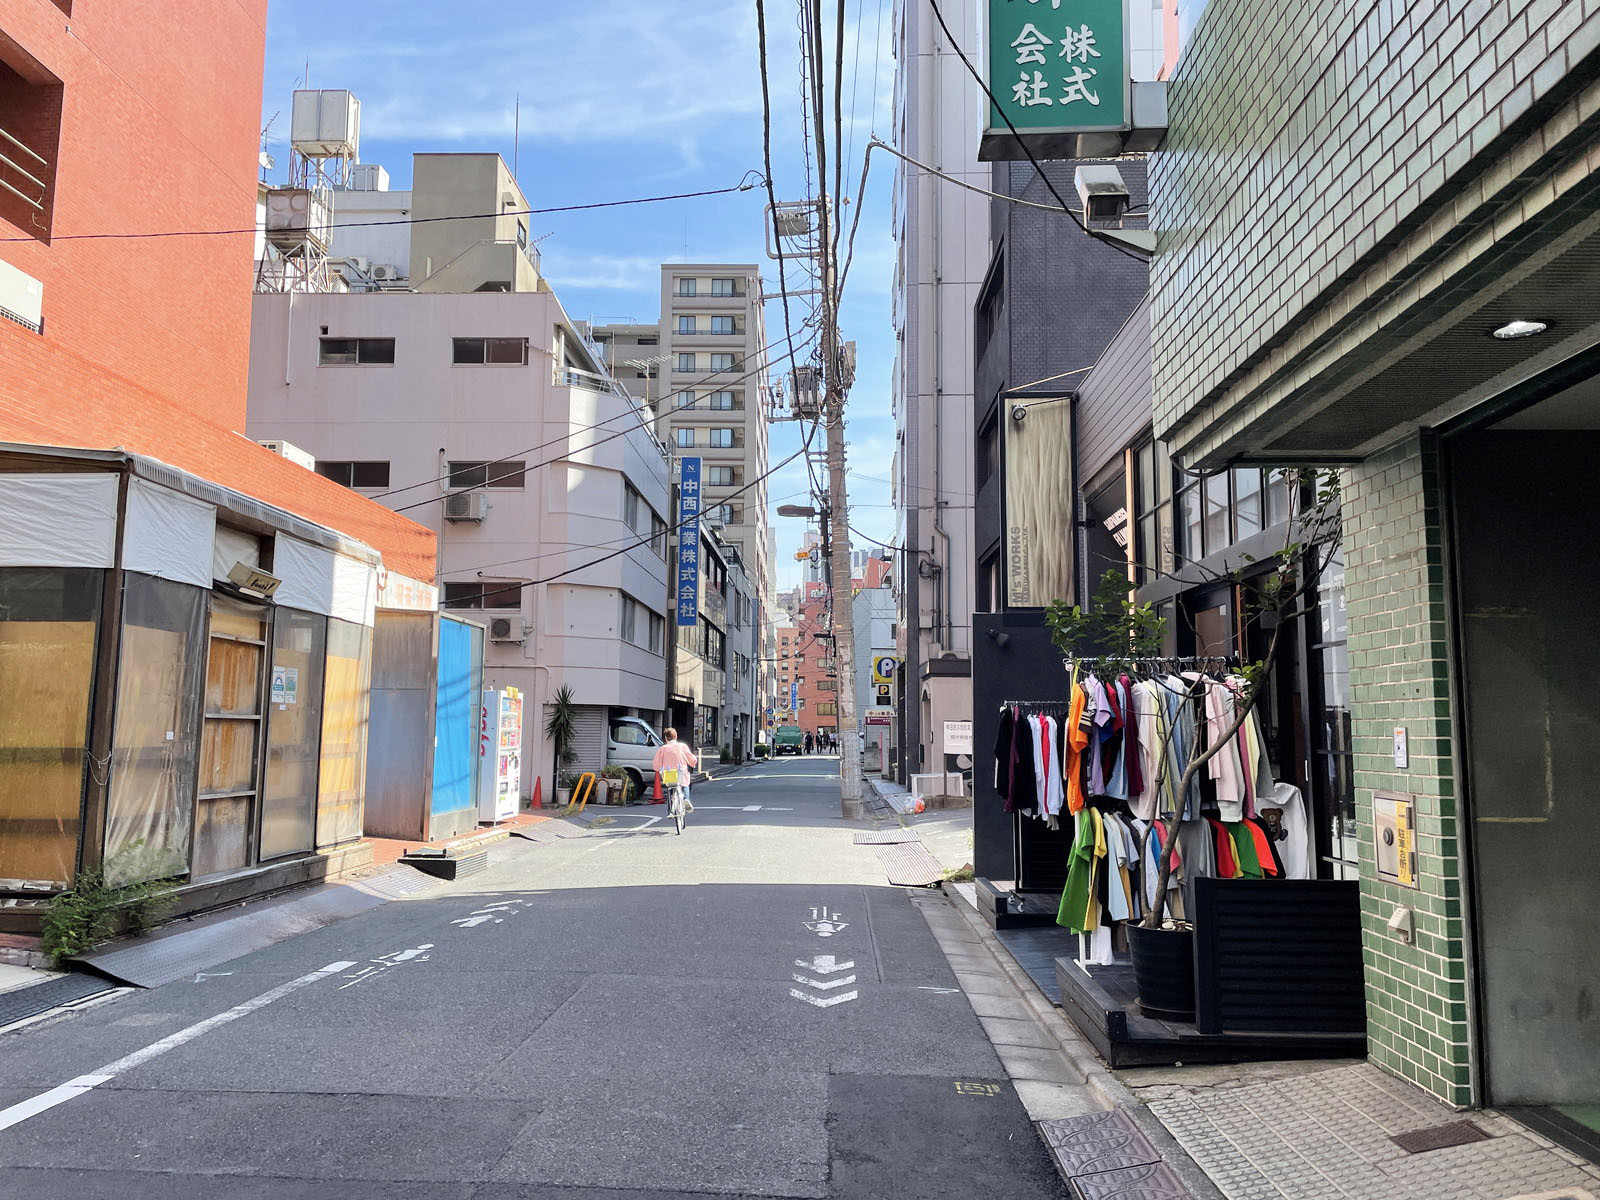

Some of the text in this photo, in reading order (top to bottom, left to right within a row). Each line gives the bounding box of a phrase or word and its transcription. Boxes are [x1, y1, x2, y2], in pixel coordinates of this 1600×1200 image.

[1010, 23, 1101, 107] 株式 会社
[680, 479, 698, 618] 中西産業株式会社
[1011, 526, 1023, 603] M's WORKS
[880, 685, 889, 695] P
[881, 658, 894, 677] P
